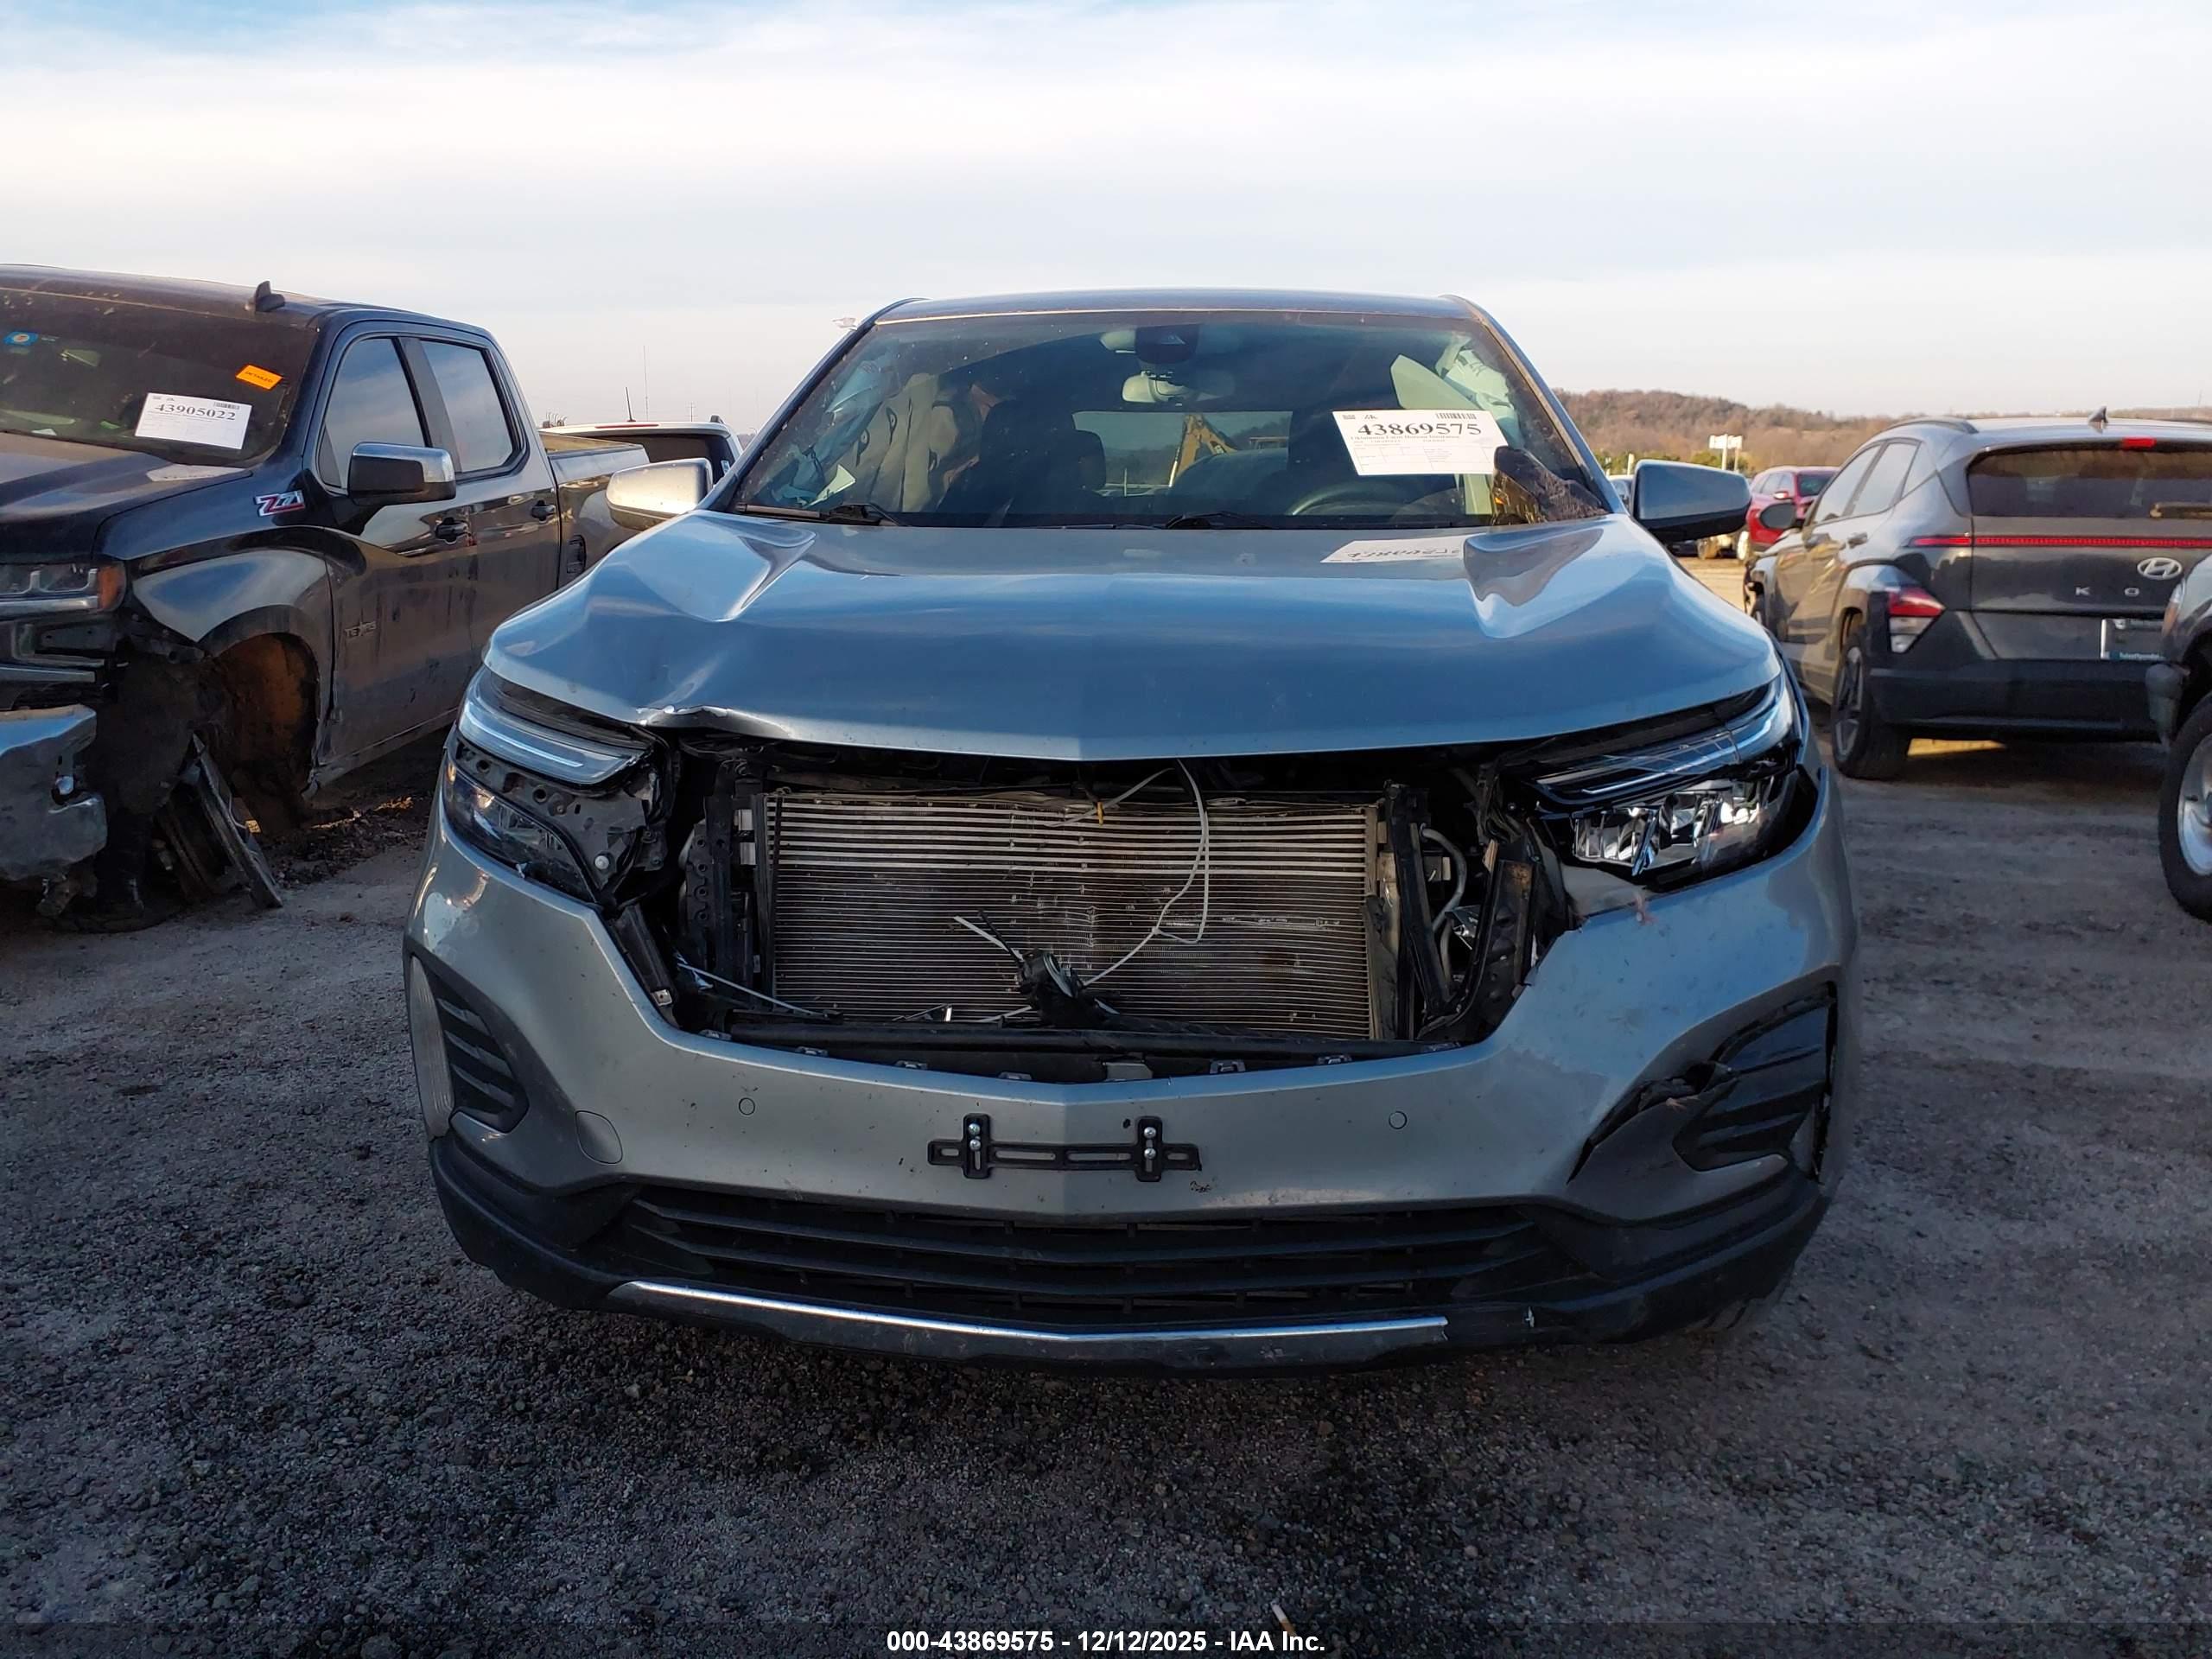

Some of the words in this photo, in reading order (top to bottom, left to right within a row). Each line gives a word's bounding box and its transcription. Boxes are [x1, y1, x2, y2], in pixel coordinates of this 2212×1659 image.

[154, 403, 236, 421] 43905022
[1357, 423, 1482, 435] 43869575
[255, 489, 306, 517] Z71
